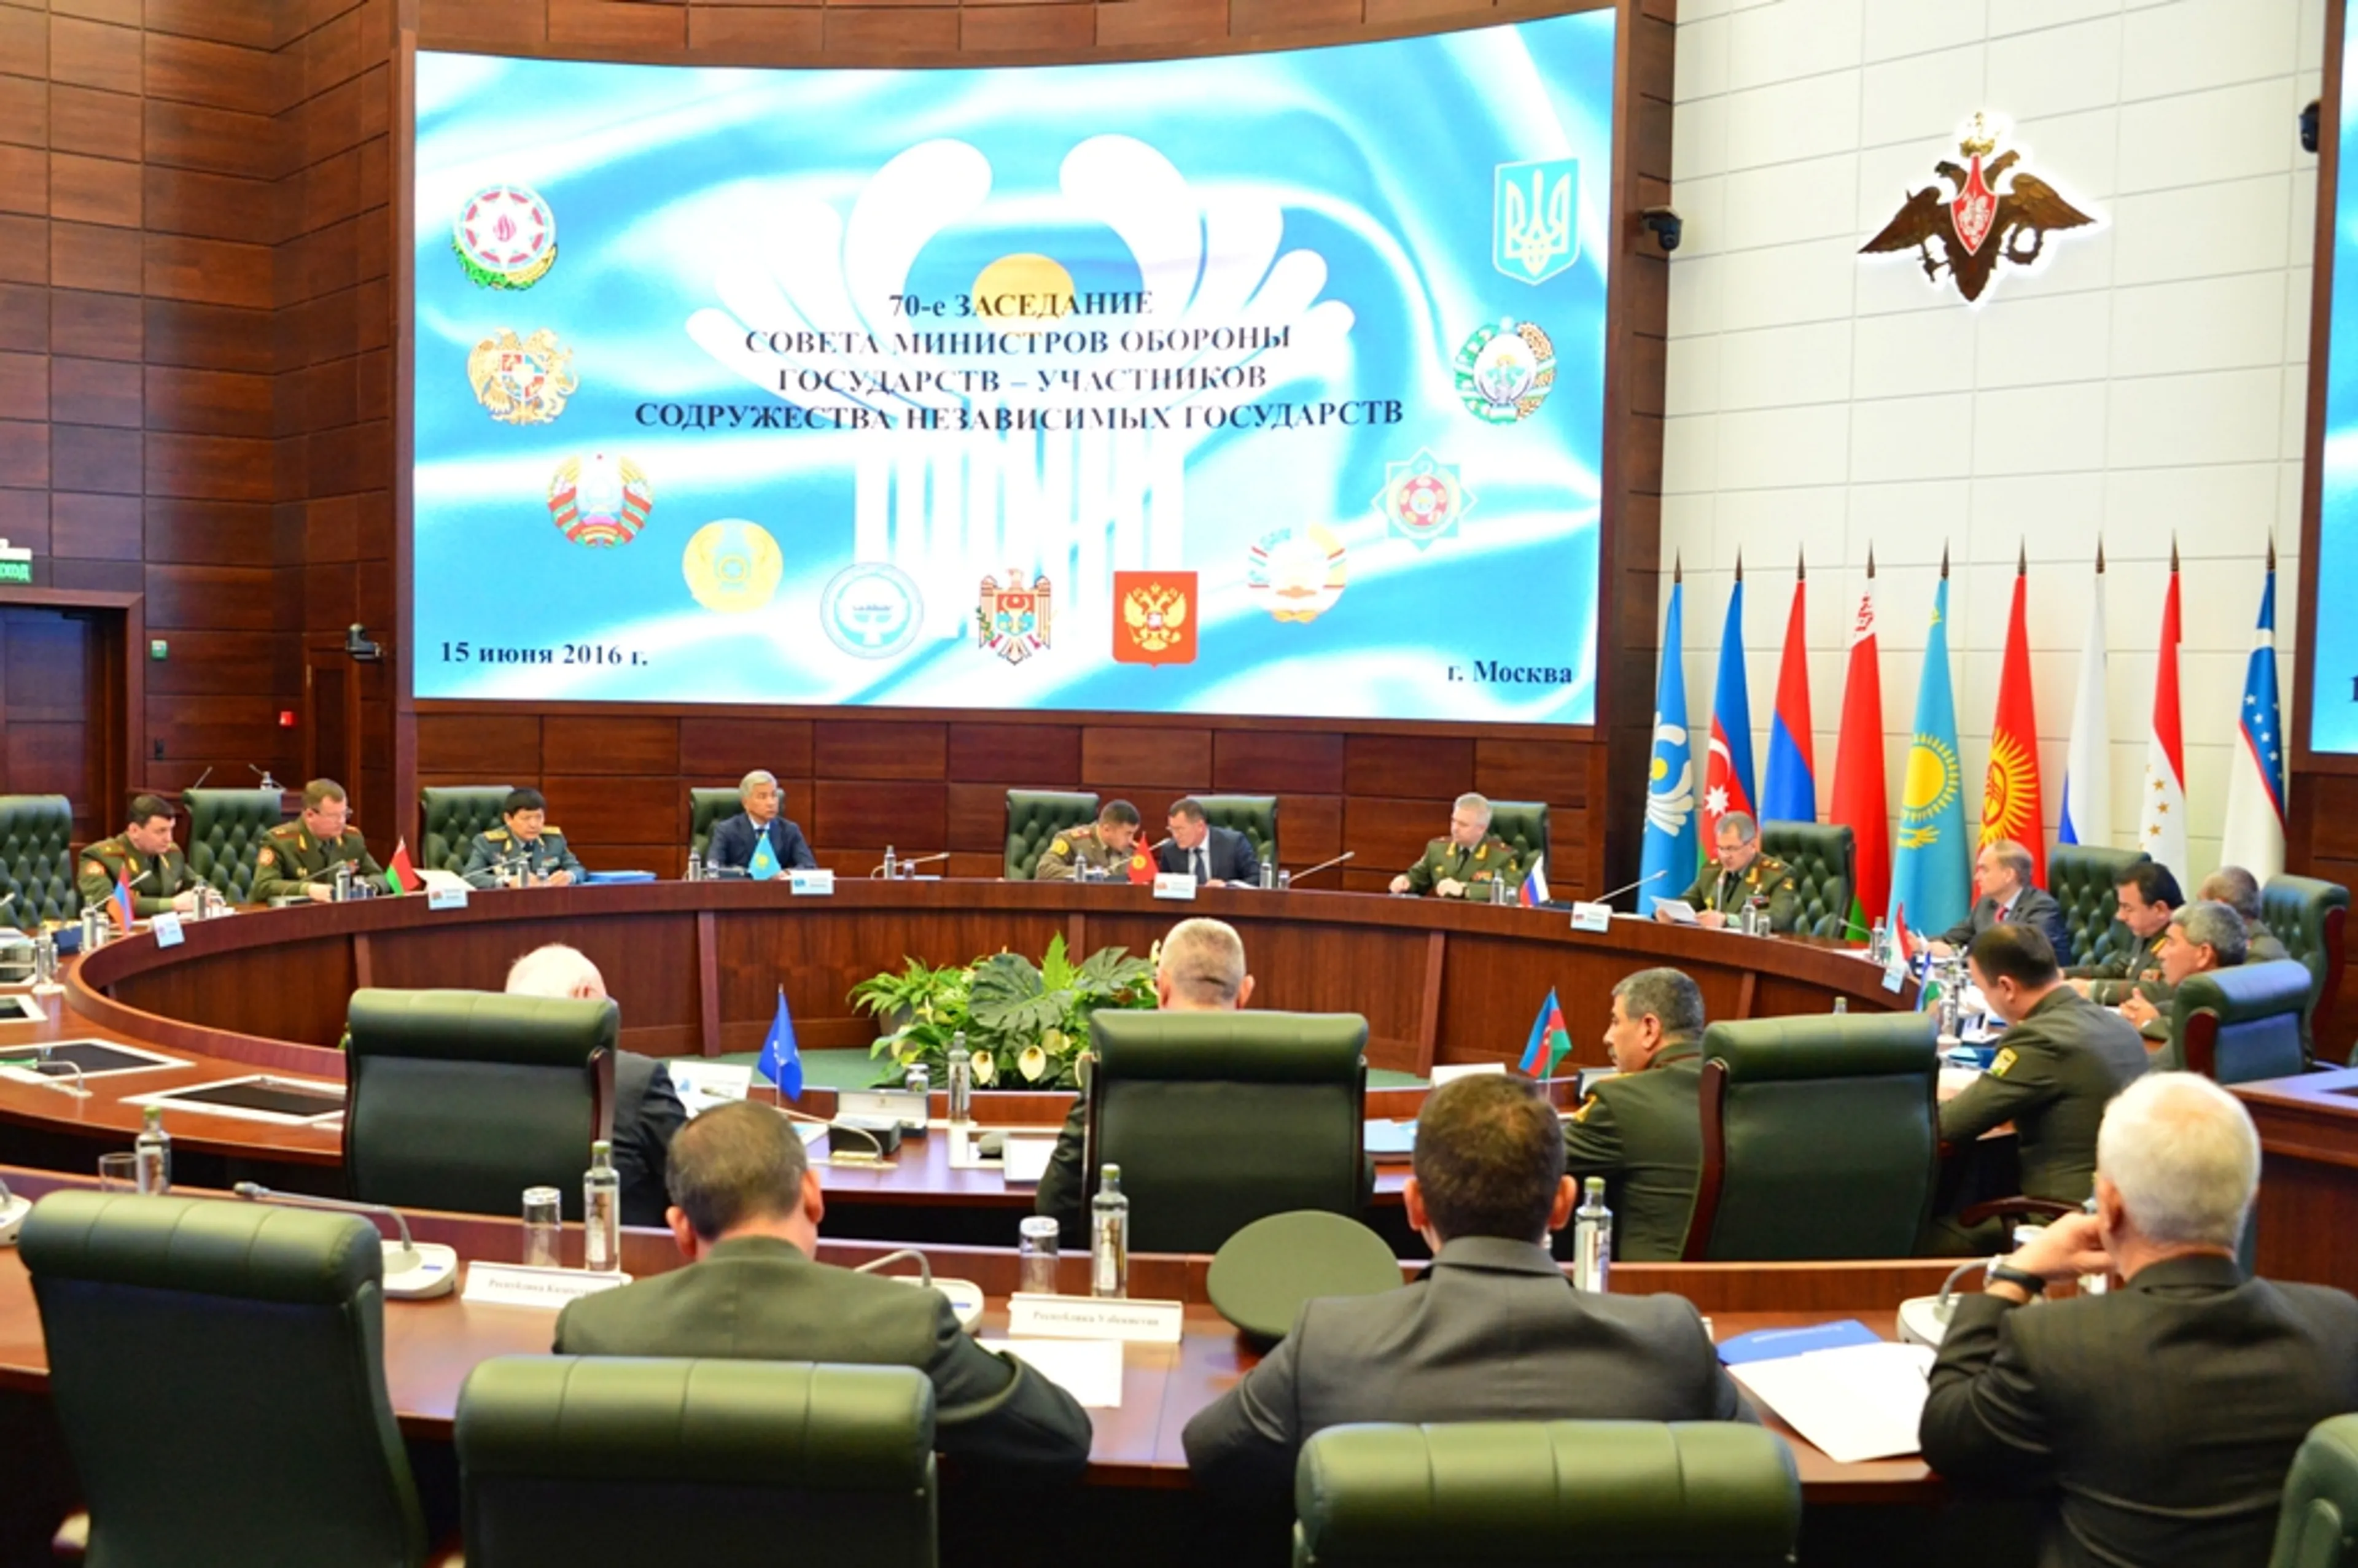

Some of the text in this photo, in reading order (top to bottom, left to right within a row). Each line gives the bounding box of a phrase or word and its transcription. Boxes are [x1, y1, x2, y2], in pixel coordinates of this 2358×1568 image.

[889, 291, 1154, 318] 70-е ЗАСЕДАНИЕ
[744, 325, 1291, 355] СОВЕТА МИНИСТРОВ ОБОРОНЫ
[777, 368, 1001, 395] ГОСУДАРСТВ
[1037, 365, 1267, 393] УЧАСТНИКОВ
[634, 400, 1404, 431] СОДРУЖЕСТВА НЕЗАВИСИМЫХ ГОСУДАРСТВ
[441, 641, 648, 666] 15 июня 2016 г.
[1447, 660, 1573, 684] г. Москва
